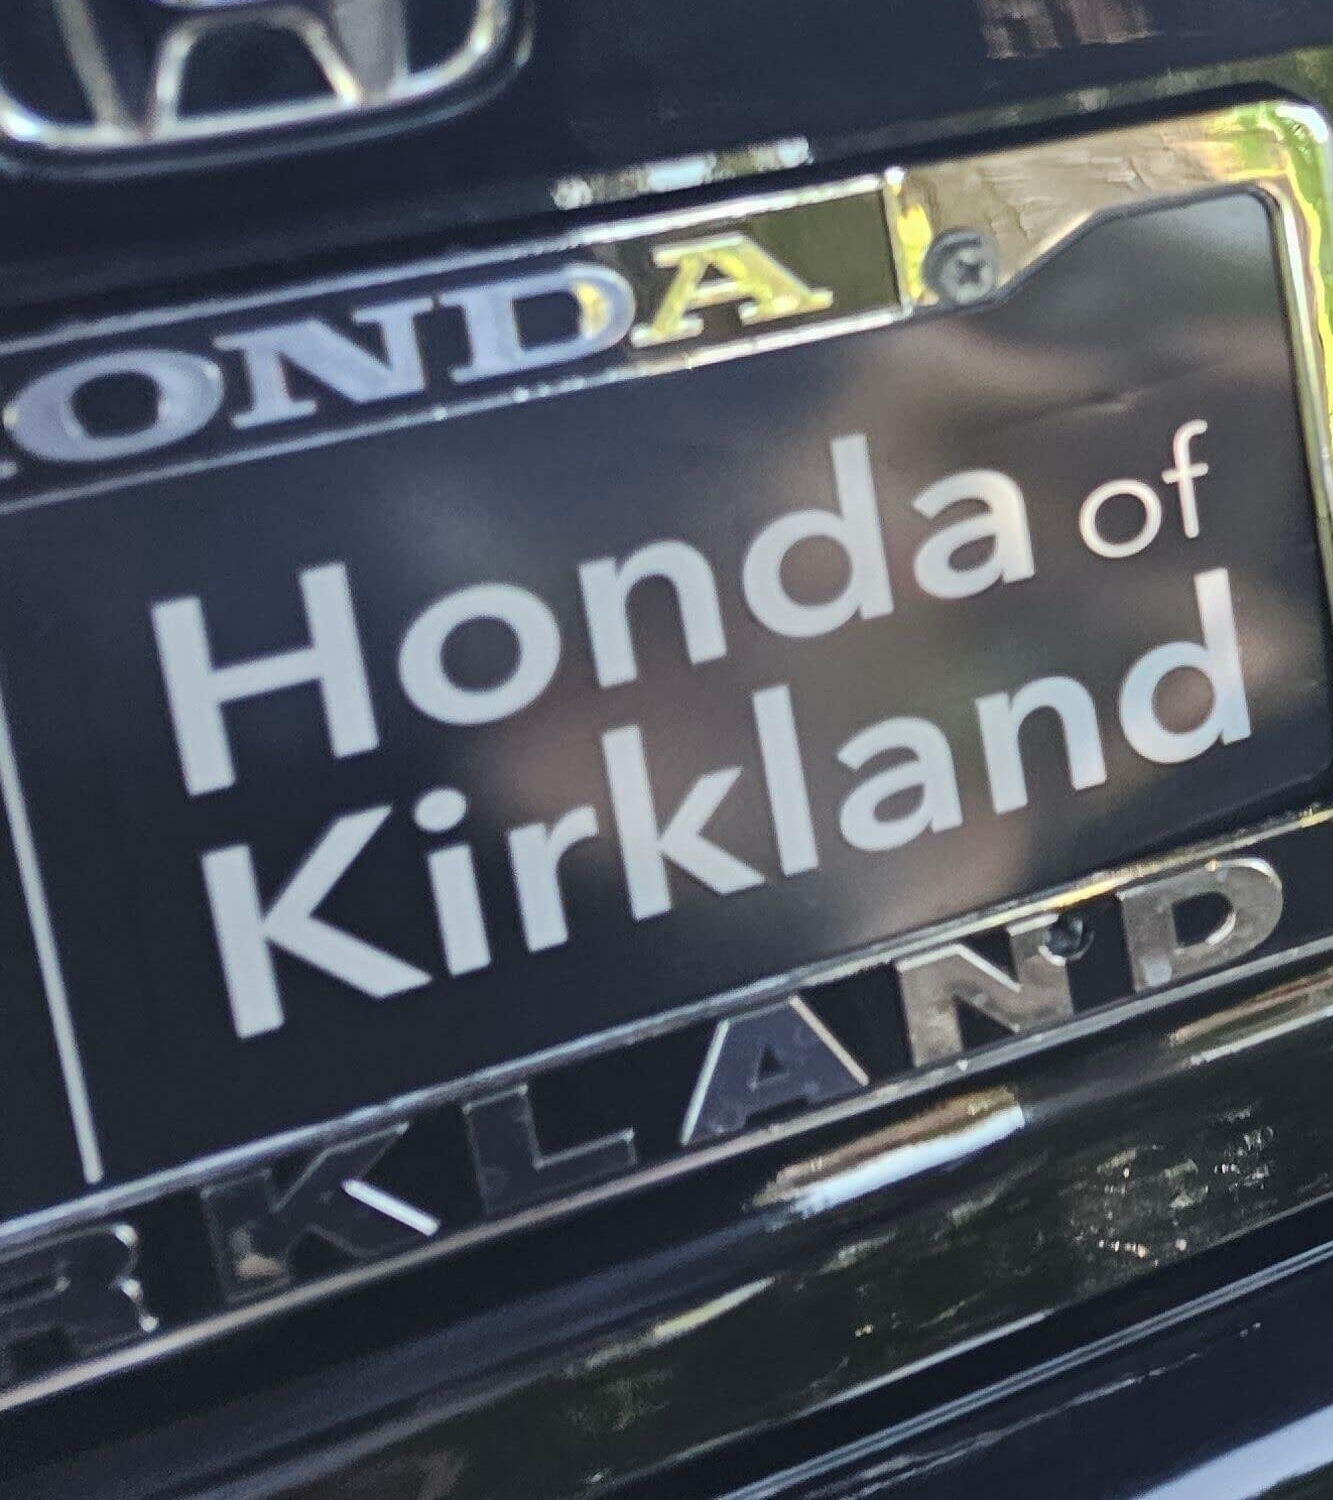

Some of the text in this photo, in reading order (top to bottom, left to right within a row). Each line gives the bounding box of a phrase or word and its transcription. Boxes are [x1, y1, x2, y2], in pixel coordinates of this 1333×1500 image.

[0, 231, 834, 478] ONDA
[150, 418, 1210, 796] Honda of
[202, 566, 1254, 1040] Kirkland
